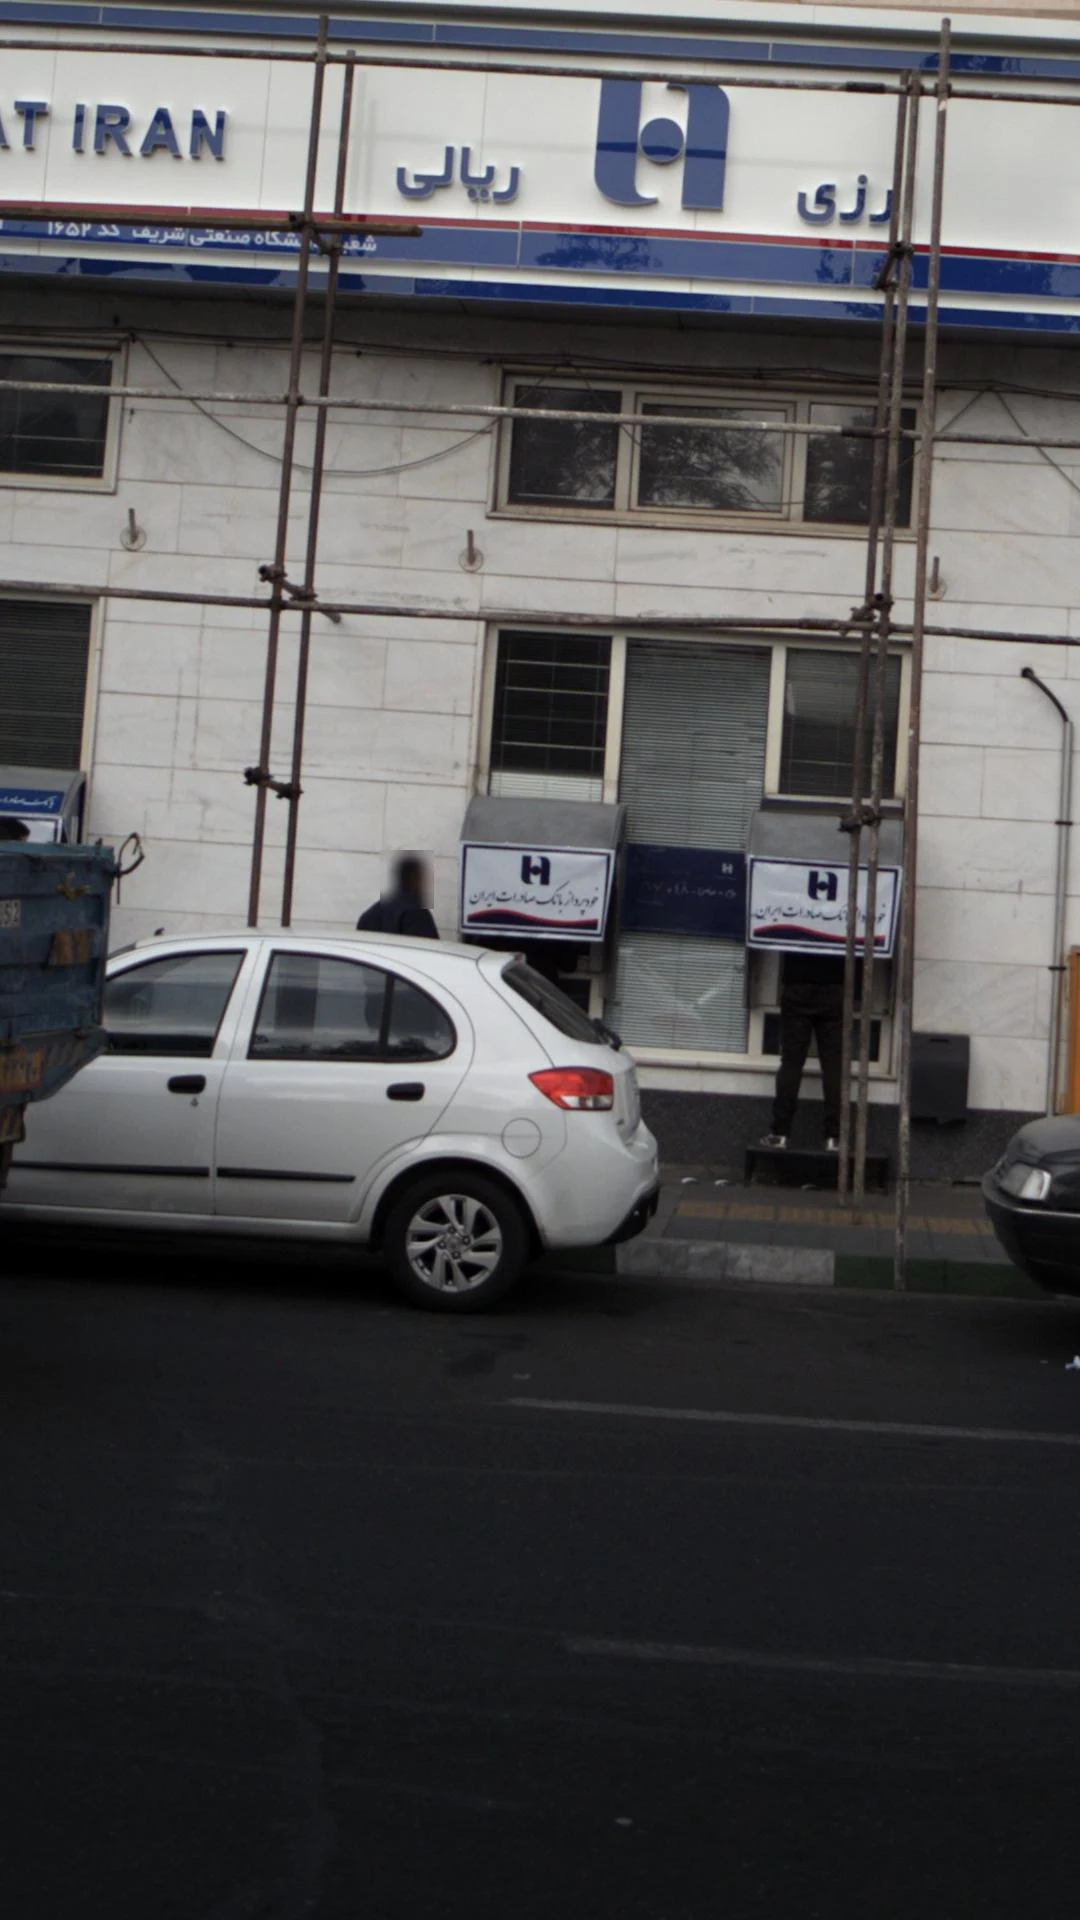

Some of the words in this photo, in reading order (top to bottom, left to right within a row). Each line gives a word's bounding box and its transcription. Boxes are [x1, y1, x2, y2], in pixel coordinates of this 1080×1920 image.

[73, 103, 227, 161] IRAN
[396, 145, 520, 201] ریالی
[797, 174, 895, 225] رزی
[132, 226, 186, 244] شریف
[190, 227, 250, 247] صنعتی
[343, 234, 377, 255] شعب
[469, 889, 496, 907] ایران
